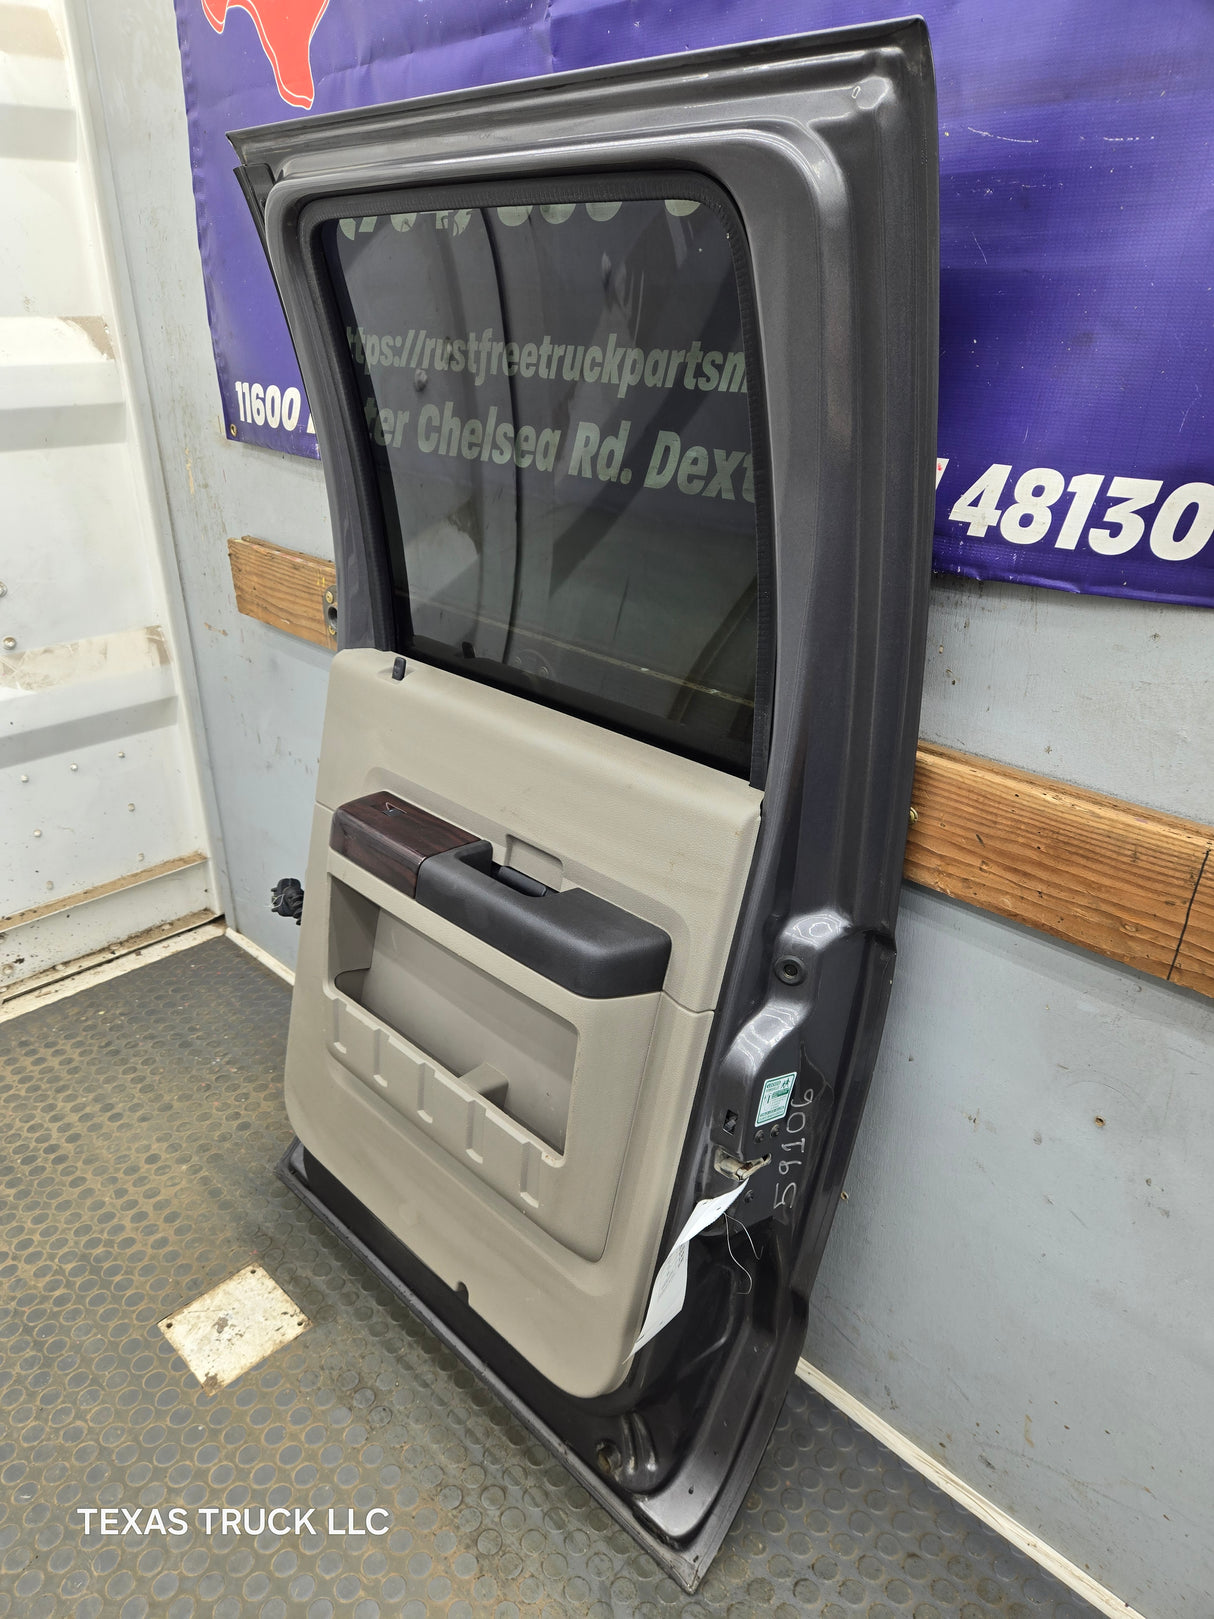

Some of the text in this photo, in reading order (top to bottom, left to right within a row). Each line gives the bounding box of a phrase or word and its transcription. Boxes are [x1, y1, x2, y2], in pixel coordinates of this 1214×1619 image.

[235, 381, 301, 431] 11600
[417, 401, 562, 472] Chelsea
[568, 420, 633, 484] Rd.
[948, 463, 1214, 561] 48130
[773, 1088, 814, 1209] 59106
